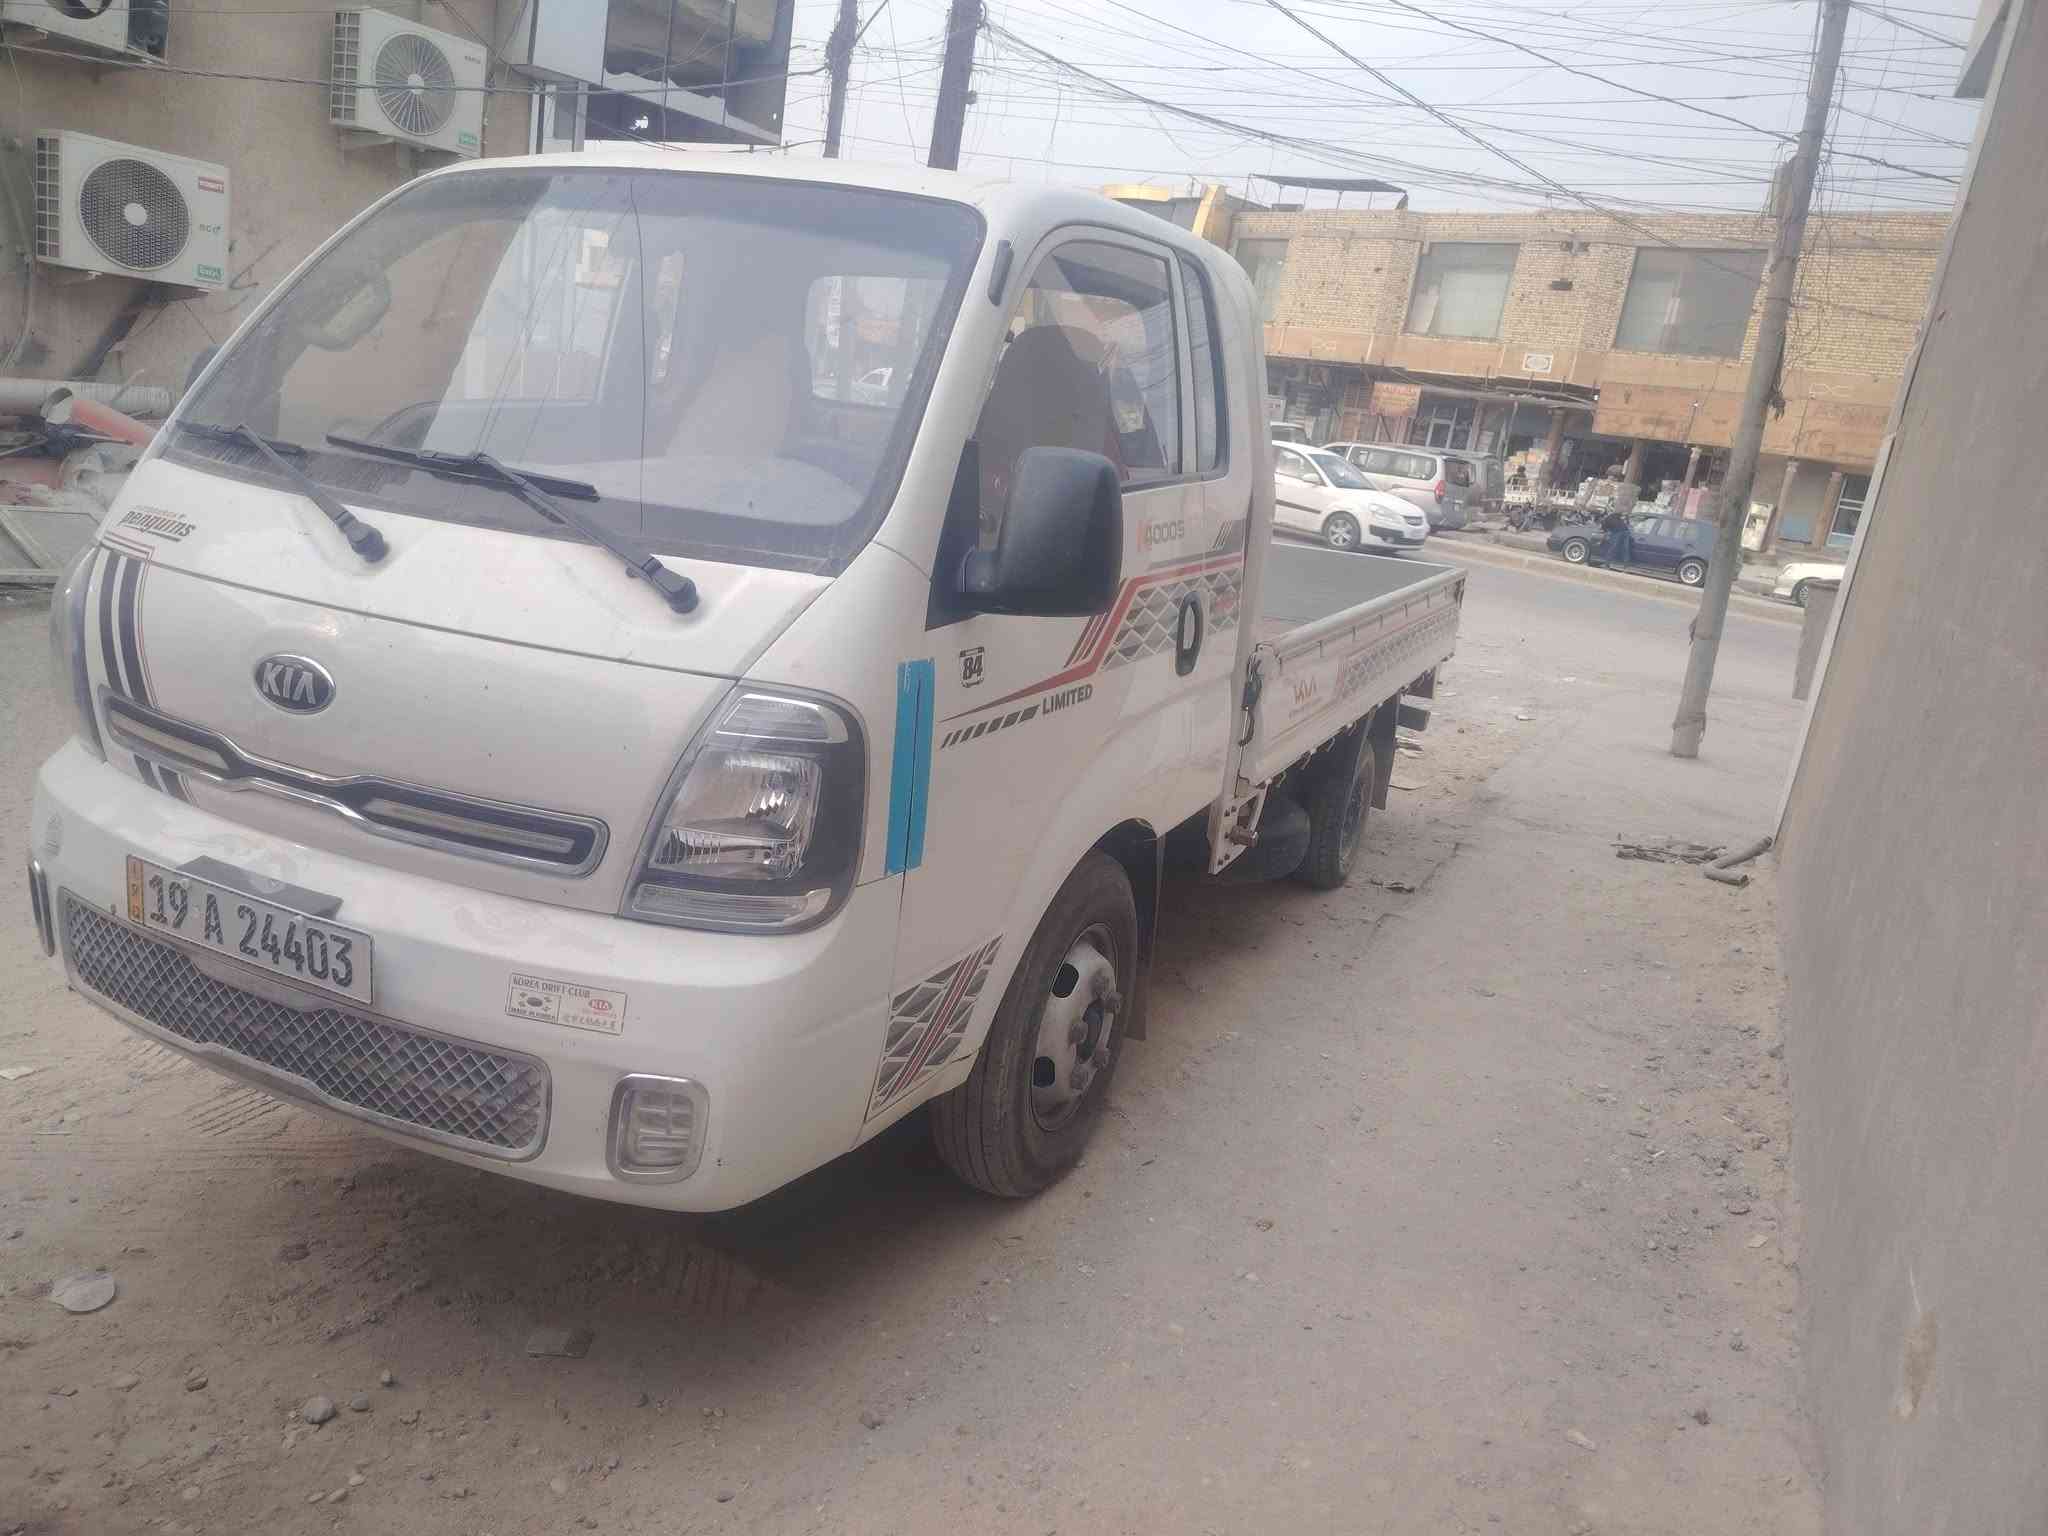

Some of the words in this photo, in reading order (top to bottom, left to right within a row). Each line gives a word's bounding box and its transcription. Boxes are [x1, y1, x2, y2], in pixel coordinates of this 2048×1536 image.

[262, 662, 317, 705] KIA
[1042, 683, 1093, 716] LIMITED
[149, 874, 189, 929] 19
[204, 893, 224, 945] A
[237, 904, 353, 988] 24403
[512, 975, 540, 990] KOREA
[541, 982, 566, 995] DRIFT
[567, 986, 591, 999] CLUB
